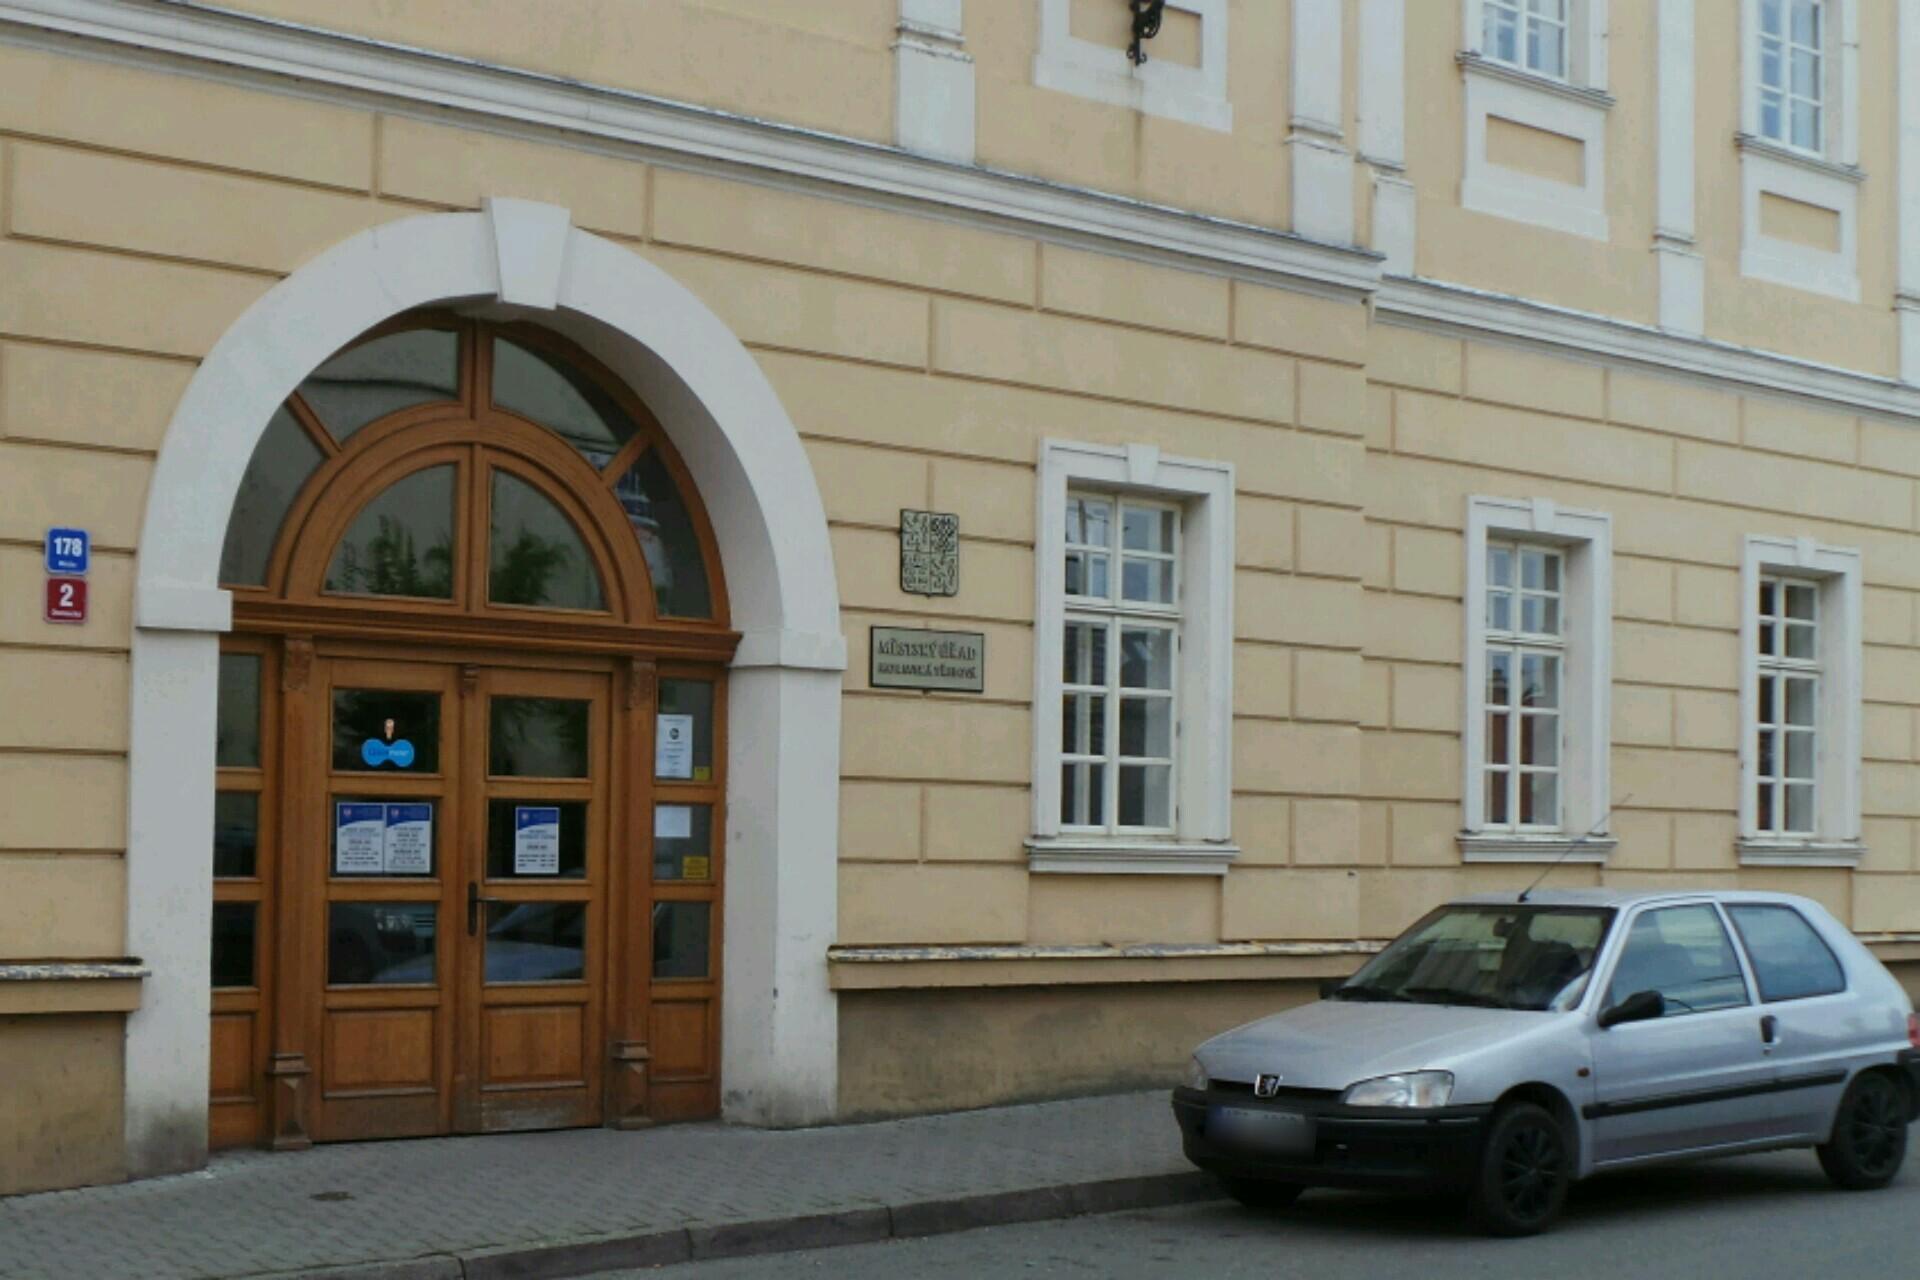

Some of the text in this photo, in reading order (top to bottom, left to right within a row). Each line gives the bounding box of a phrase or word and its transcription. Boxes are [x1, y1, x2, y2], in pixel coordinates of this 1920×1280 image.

[54, 537, 82, 557] 178
[60, 583, 73, 607] 2
[878, 638, 936, 658] MĚSTSKÝ
